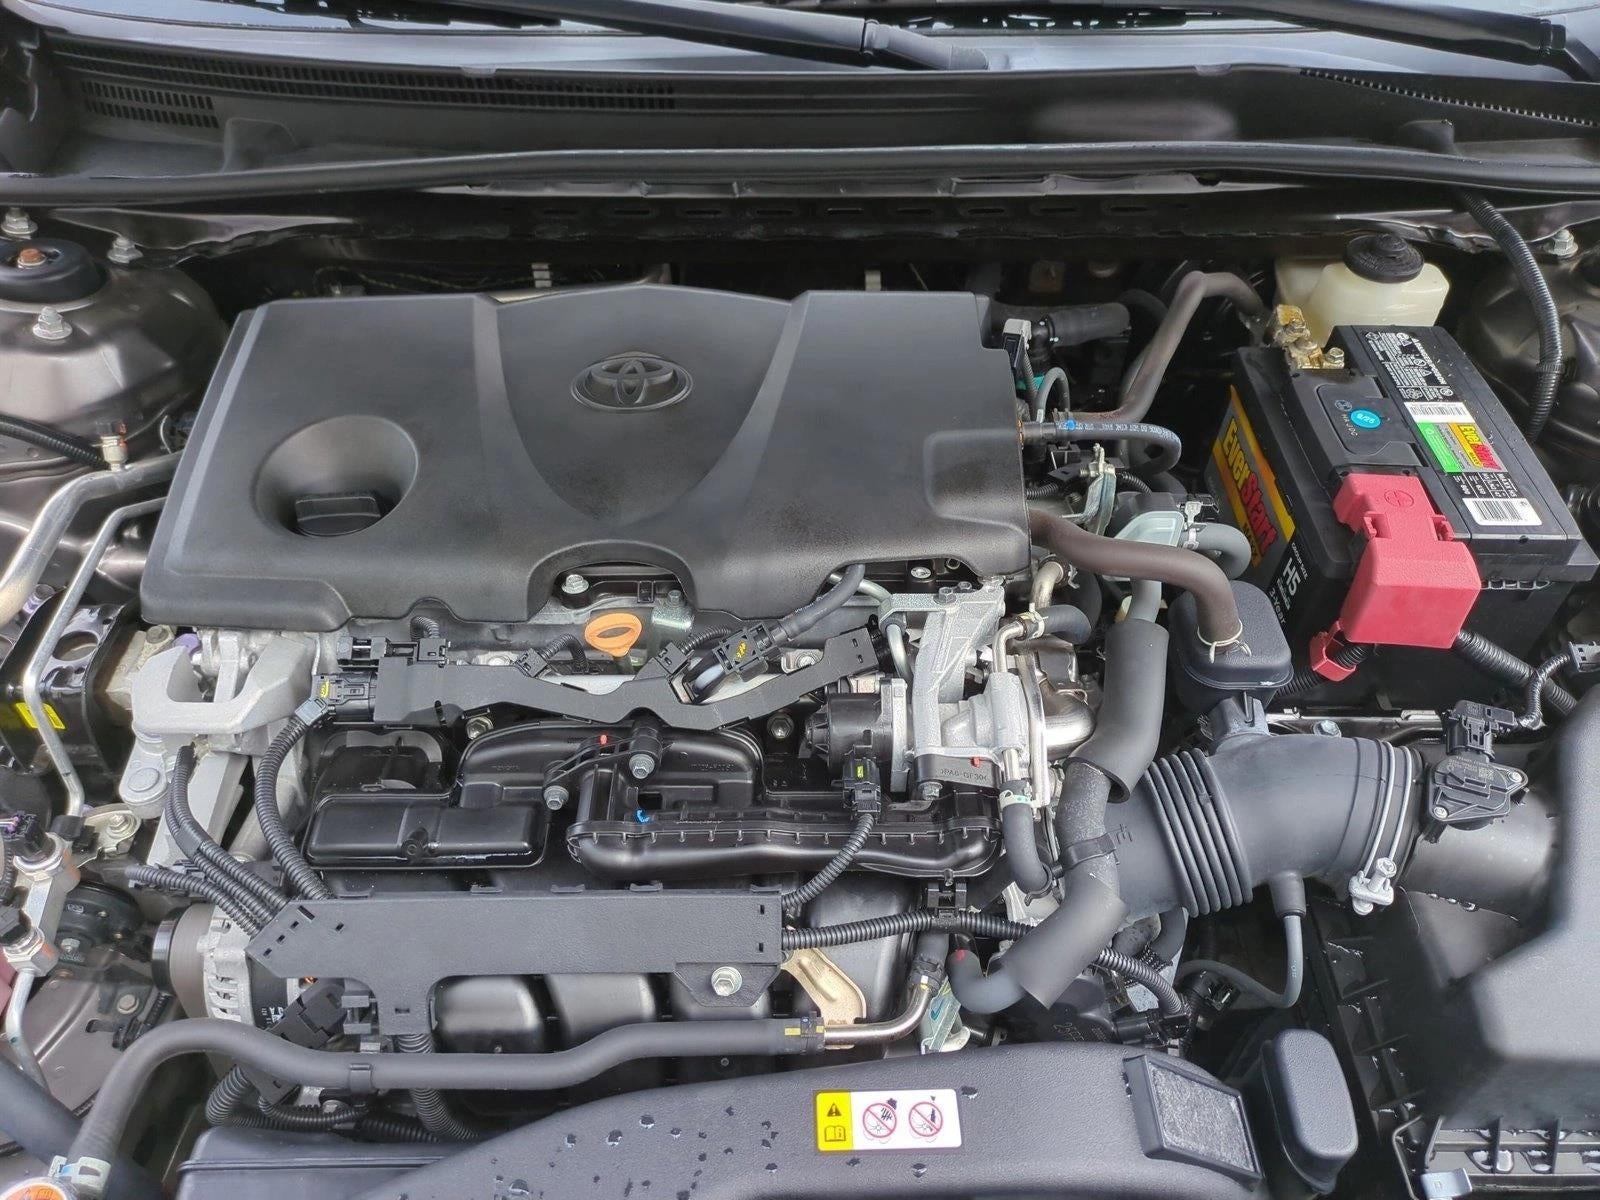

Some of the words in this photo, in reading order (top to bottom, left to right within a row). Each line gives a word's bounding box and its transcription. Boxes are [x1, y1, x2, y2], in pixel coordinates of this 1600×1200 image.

[1223, 417, 1277, 557] EverStart
[1282, 556, 1301, 596] H5
[1269, 587, 1286, 624] 3-Year
